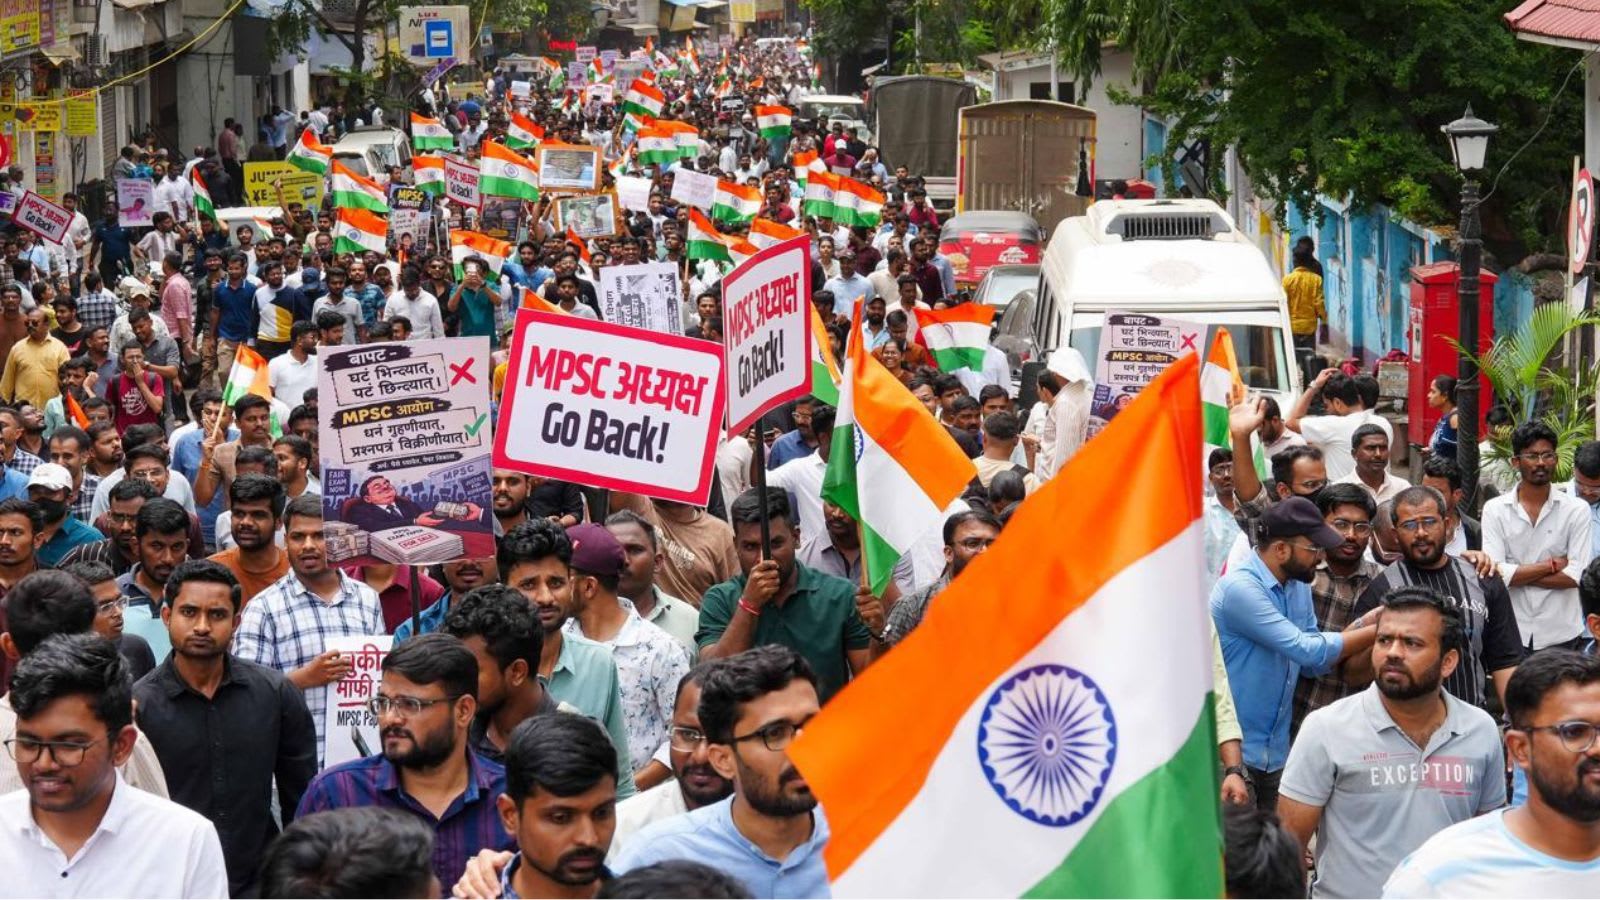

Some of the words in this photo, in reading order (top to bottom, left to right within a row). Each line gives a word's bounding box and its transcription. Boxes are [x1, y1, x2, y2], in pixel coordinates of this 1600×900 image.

[25, 210, 36, 222] Go
[35, 216, 56, 233] Back!
[729, 291, 755, 351] MPSC
[756, 272, 799, 327] अध्यक्ष
[348, 349, 387, 365] बापट
[738, 354, 750, 398] Go
[752, 329, 784, 389] Back!
[1112, 352, 1143, 360] MPSC
[348, 368, 370, 383] घटं
[524, 345, 612, 400] MPSC
[613, 361, 709, 417] अध्यक्ष
[352, 384, 374, 398] पटं
[342, 405, 393, 425] MPSC
[396, 400, 435, 416] आयोग
[364, 424, 383, 438] धनं
[540, 402, 581, 446] Go
[584, 409, 670, 464] Back!
[350, 440, 394, 457] प्रश्नपत्रं
[328, 470, 346, 478] FAIR
[443, 465, 474, 480] MPSC
[337, 673, 374, 698] माफी
[337, 710, 361, 726] MPSC
[1370, 763, 1474, 786] EXCEPTION
